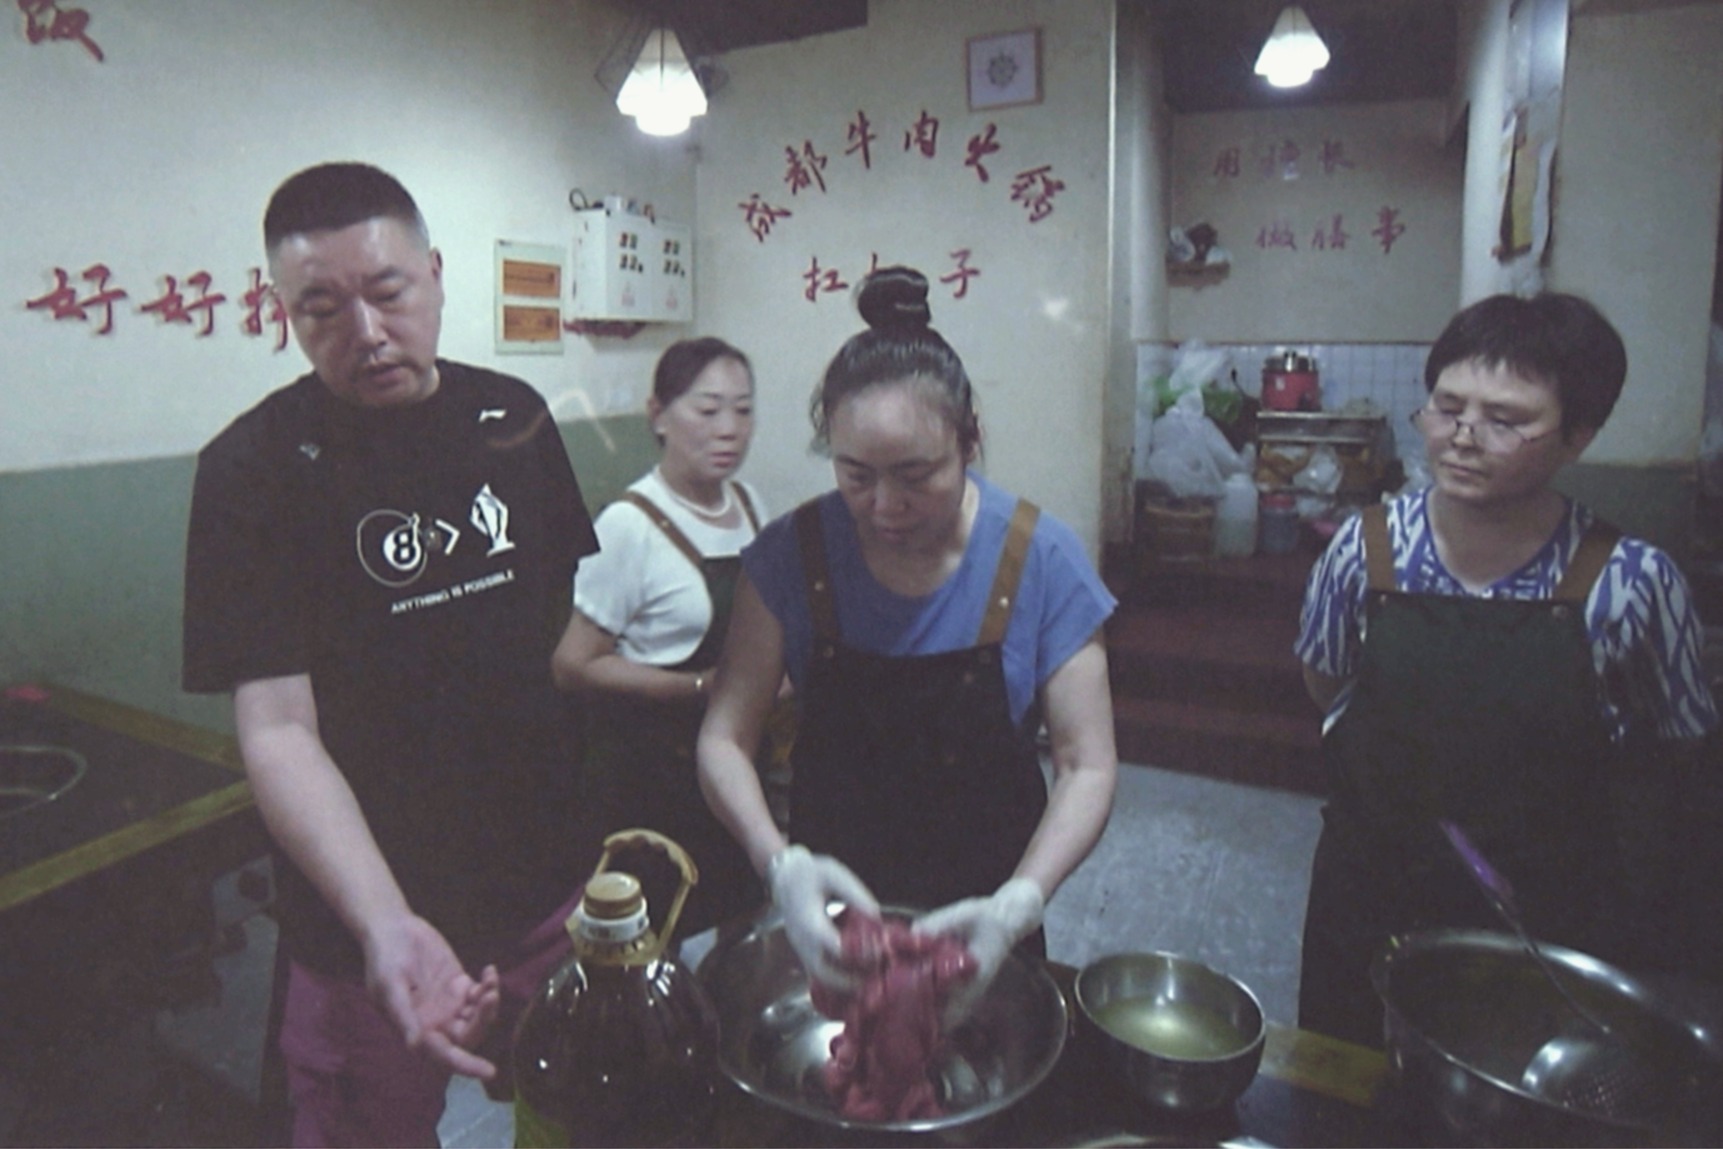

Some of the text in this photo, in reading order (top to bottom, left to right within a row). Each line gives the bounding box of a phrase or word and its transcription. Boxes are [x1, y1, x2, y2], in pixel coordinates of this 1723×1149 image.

[738, 109, 1066, 243] 成都牛肉火锅
[802, 248, 981, 302] 扛子
[391, 569, 515, 614] ANYTHING IS POSSIBLE
